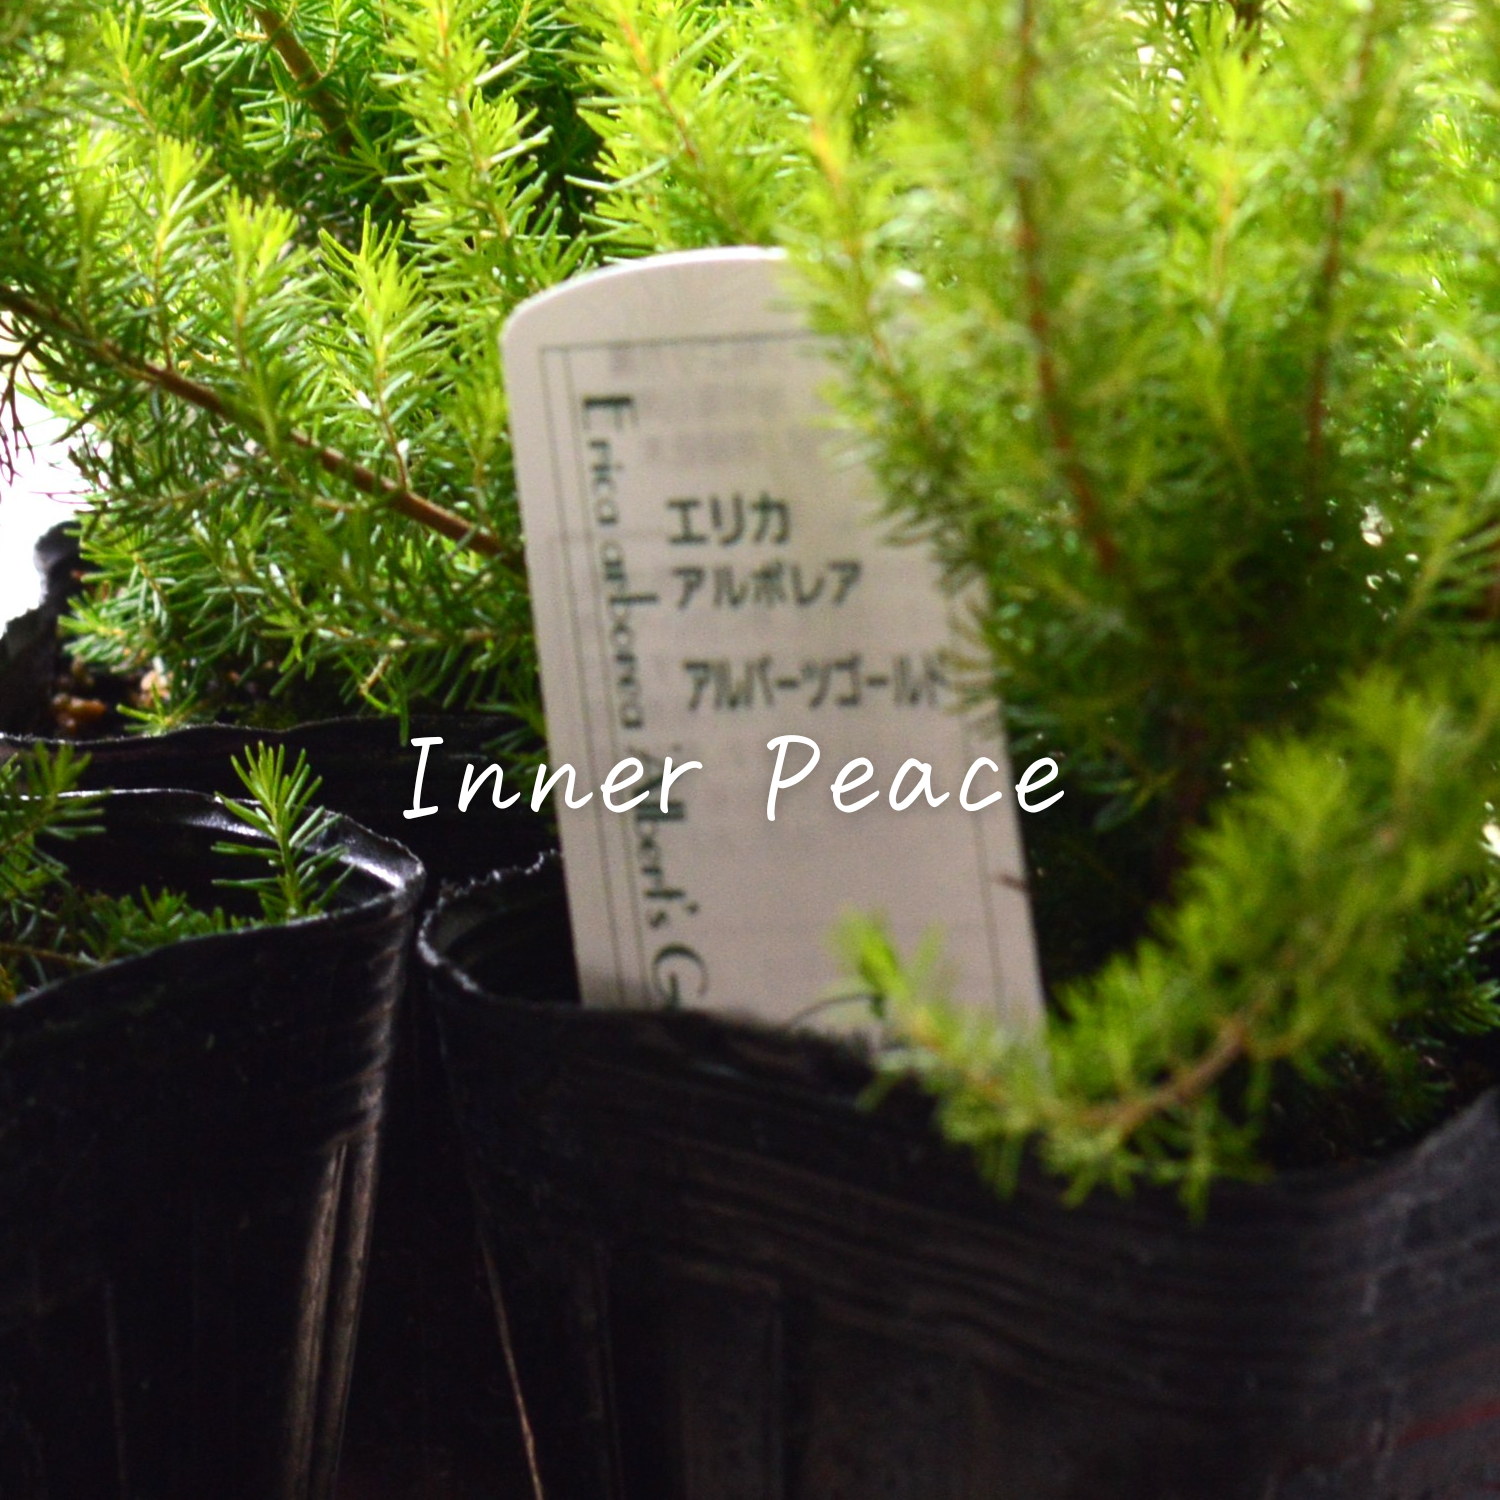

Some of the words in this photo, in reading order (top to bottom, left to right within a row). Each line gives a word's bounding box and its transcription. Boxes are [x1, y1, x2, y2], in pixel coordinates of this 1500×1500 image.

[582, 394, 639, 526] Erica
[665, 492, 791, 545] エリカ
